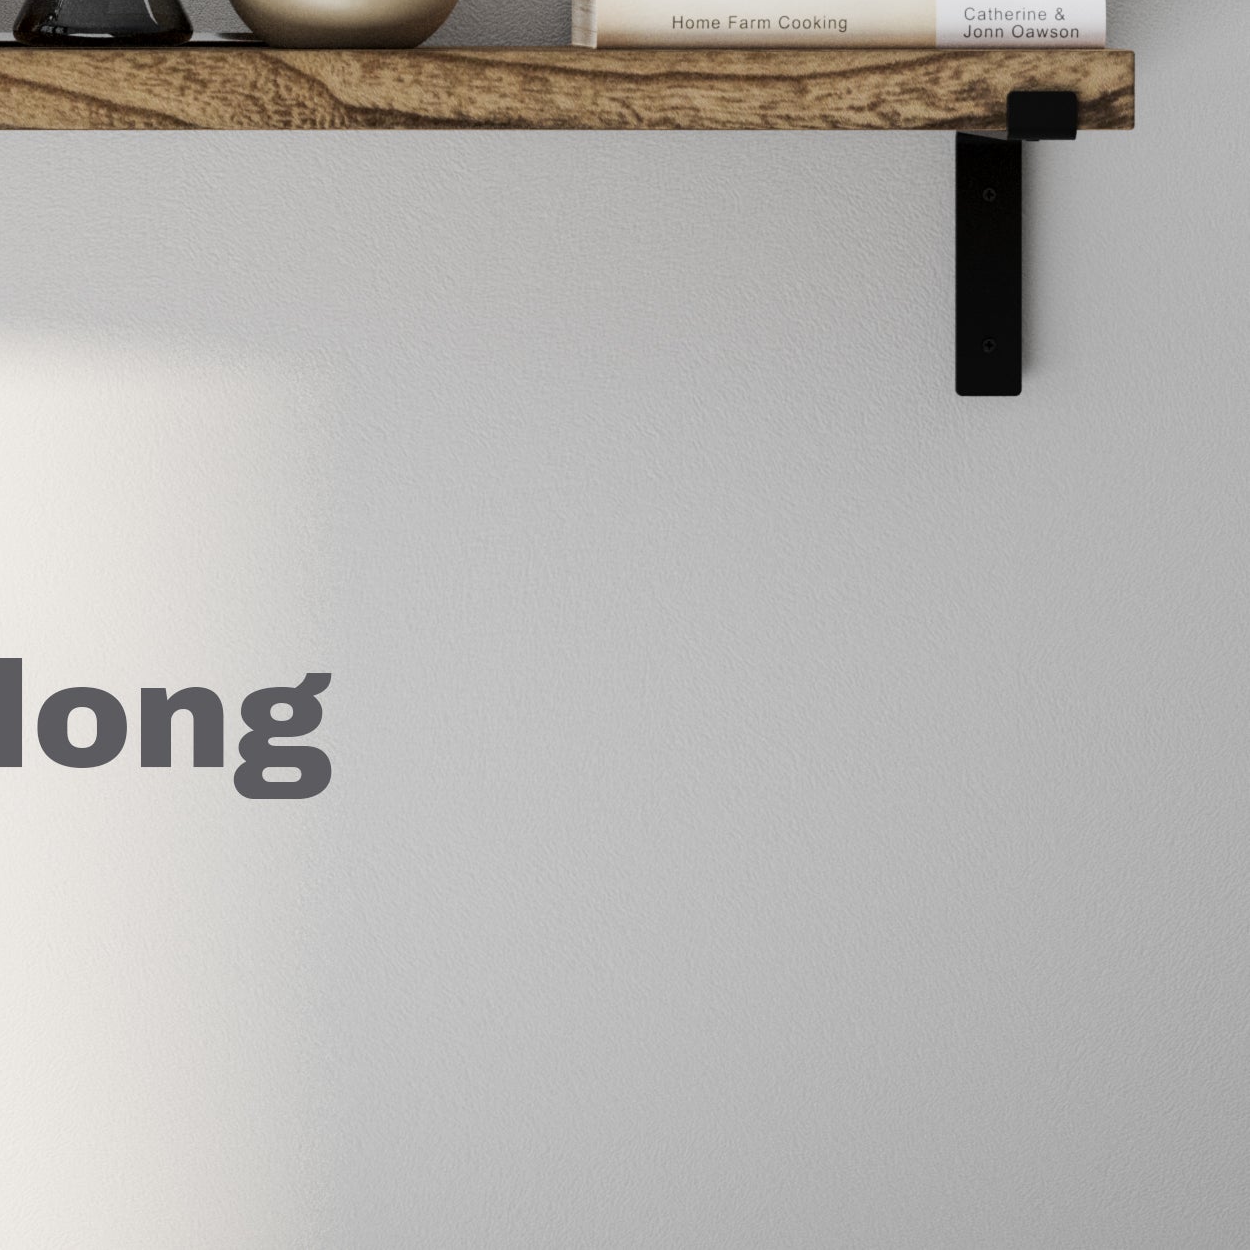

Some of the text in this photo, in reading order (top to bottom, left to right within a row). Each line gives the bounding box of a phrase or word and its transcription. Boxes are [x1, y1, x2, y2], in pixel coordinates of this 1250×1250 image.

[964, 7, 1066, 21] Catherine &
[672, 15, 848, 34] Home Farm Cooking
